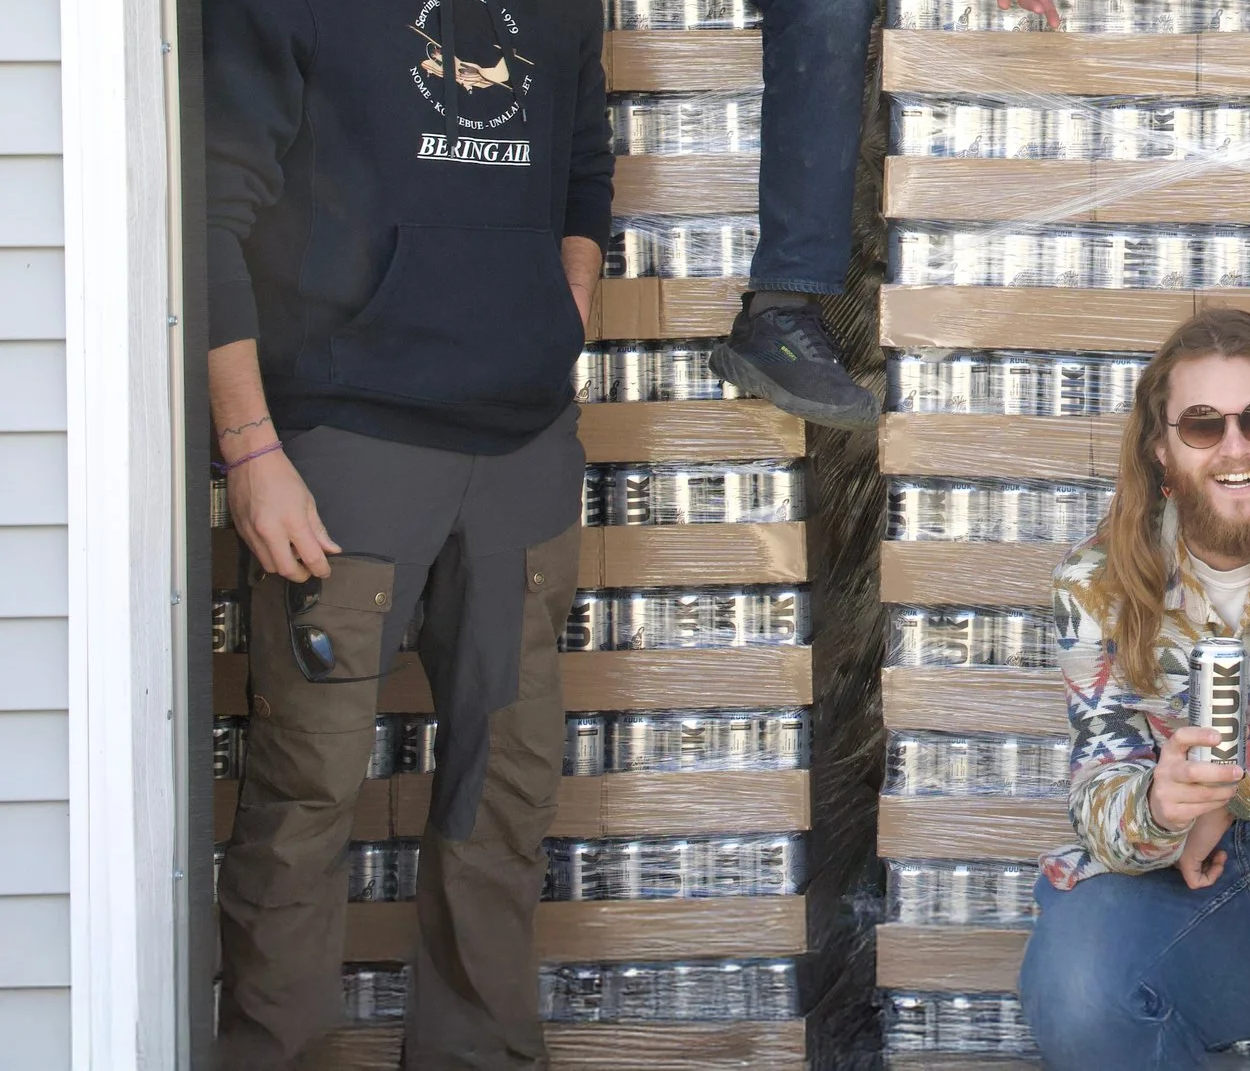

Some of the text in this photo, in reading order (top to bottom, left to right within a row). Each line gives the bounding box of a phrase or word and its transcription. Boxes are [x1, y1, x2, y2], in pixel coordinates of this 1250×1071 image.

[410, 66, 432, 99] NOME
[418, 137, 530, 162] BERING AIR
[1211, 661, 1241, 765] KUUK
